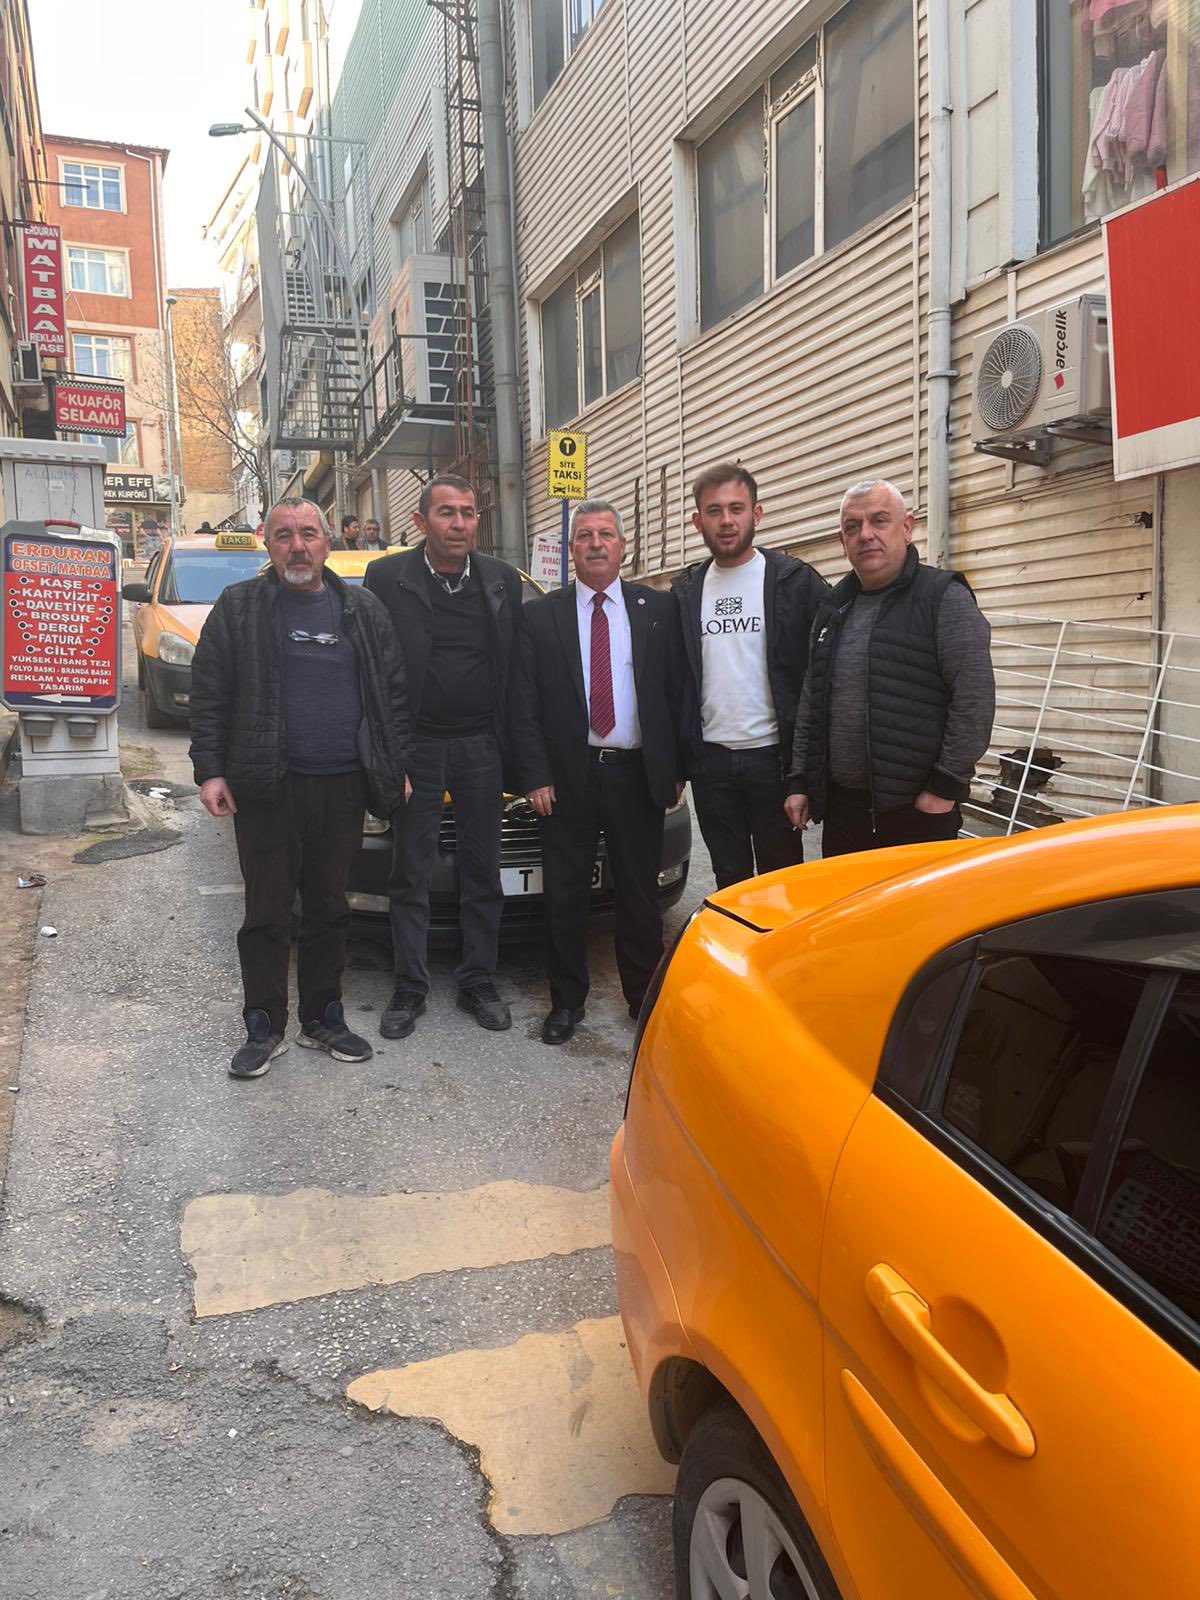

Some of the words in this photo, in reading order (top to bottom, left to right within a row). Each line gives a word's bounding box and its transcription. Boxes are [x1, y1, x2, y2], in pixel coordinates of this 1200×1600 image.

[28, 238, 59, 332] MATBAA
[30, 332, 63, 343] REKLAM
[1055, 310, 1068, 369] arçelik
[39, 344, 64, 354] AŞE
[68, 393, 121, 411] KUAFÖR
[564, 440, 572, 454] T
[104, 476, 124, 486] ER
[128, 477, 152, 487] EFE
[12, 542, 111, 564] ERDURAN
[12, 560, 54, 572] OFSET
[58, 564, 110, 577] MATBAA
[40, 578, 82, 590] KAŞE
[22, 588, 100, 603] KARTVİZİT
[26, 600, 95, 613] DAVETİYE
[31, 612, 90, 622] BROŞÜR
[38, 622, 84, 634] DERGİ
[701, 616, 761, 636] LOEWE
[38, 634, 82, 645] FATURA
[45, 644, 76, 656] CİLT
[11, 655, 51, 664] YÜKSEK
[54, 657, 87, 666] LİSANS
[90, 658, 111, 667] TEZİ
[10, 664, 32, 672] FOLYO
[34, 665, 55, 674] BASKI
[61, 667, 89, 675] BRANDA
[91, 668, 112, 676] BASKI
[11, 674, 53, 683] REKLAM
[72, 675, 109, 685] GRAFİK
[39, 684, 84, 692] TASARIM
[519, 869, 533, 891] T
